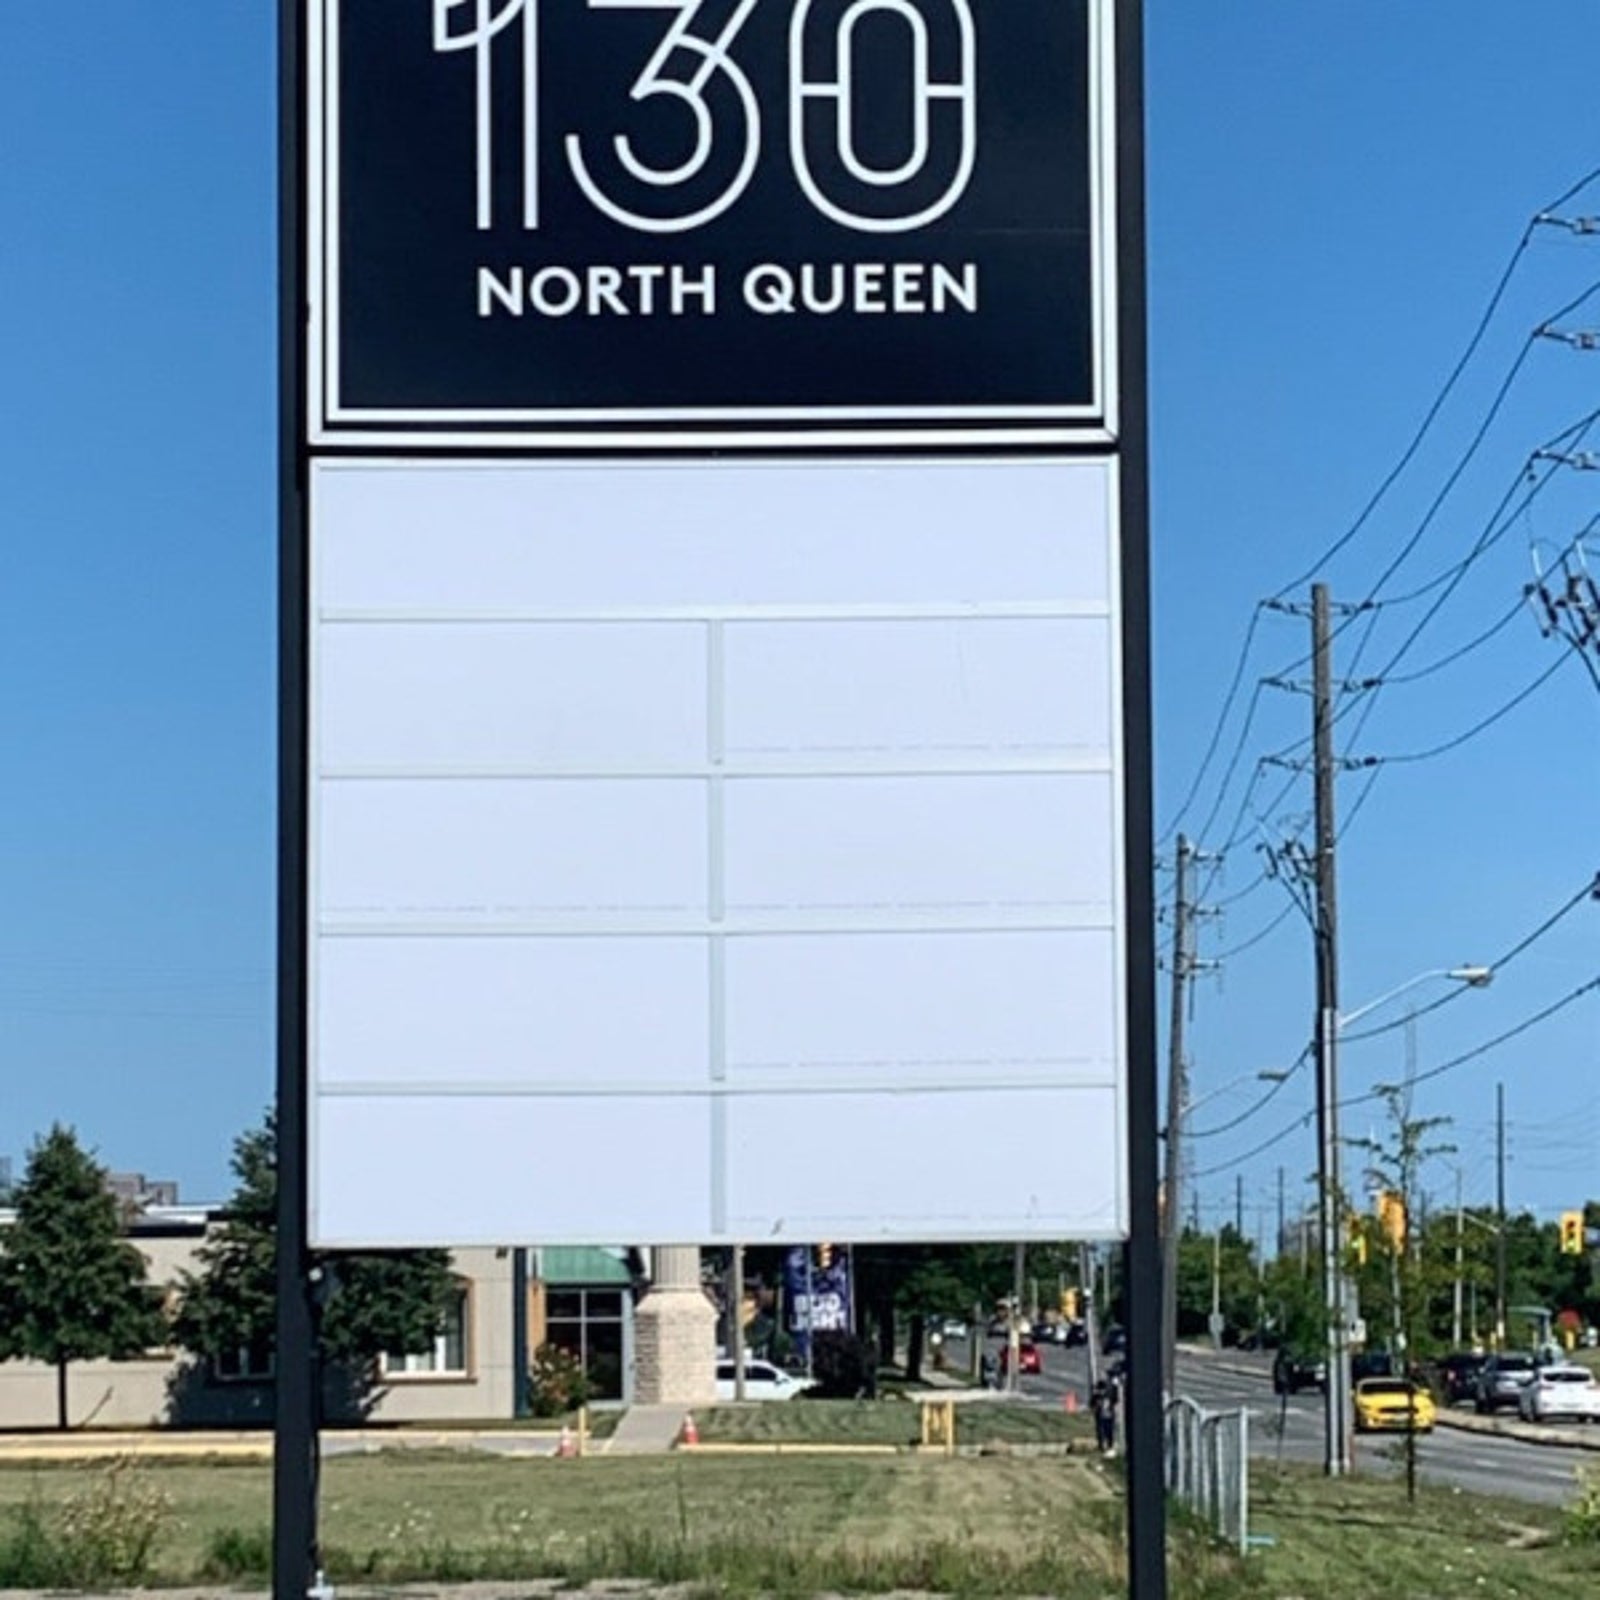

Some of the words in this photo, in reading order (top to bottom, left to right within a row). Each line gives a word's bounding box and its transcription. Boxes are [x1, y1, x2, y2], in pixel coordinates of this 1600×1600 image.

[433, 0, 977, 233] 130
[478, 265, 715, 316] NORTH
[743, 263, 978, 315] QUEEN
